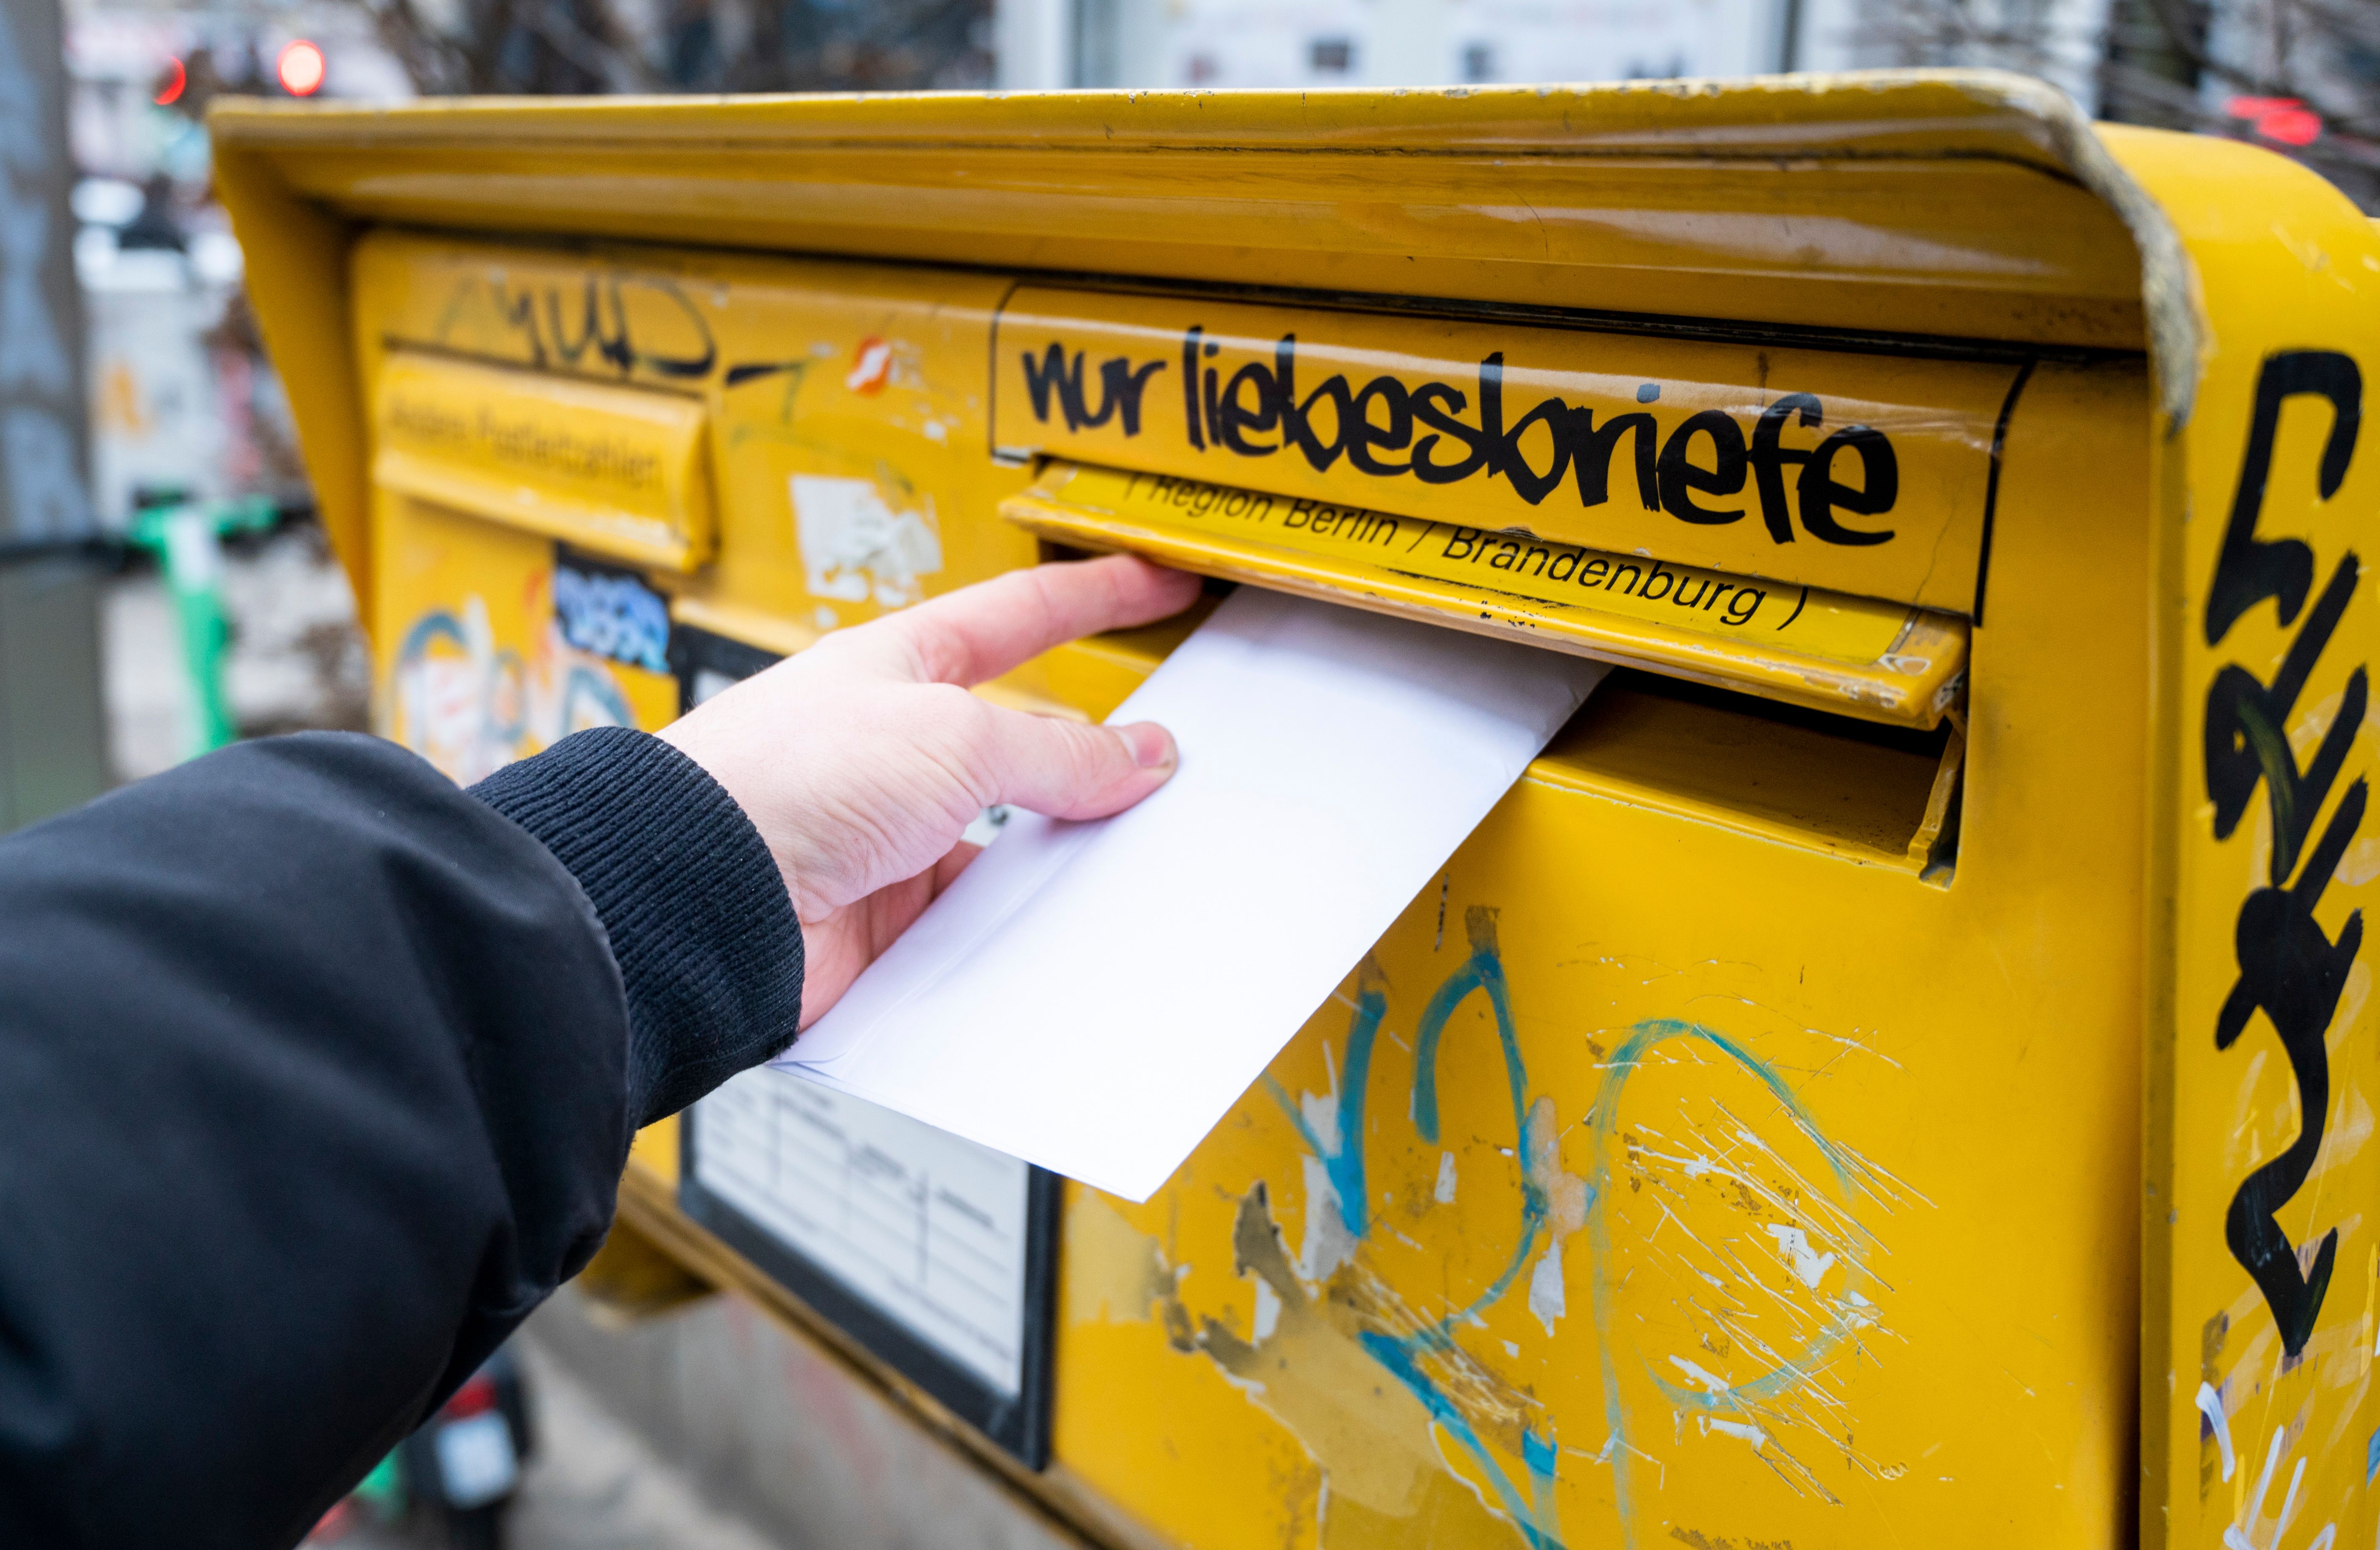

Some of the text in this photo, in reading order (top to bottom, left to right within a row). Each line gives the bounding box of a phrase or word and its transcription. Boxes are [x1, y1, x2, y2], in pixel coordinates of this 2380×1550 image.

[1182, 325, 1898, 546] liebesbriefe
[1148, 476, 1273, 522] Region
[1283, 498, 1399, 546] Berlin
[1442, 526, 1767, 626] Brandenburg
[1776, 587, 1808, 631] )
